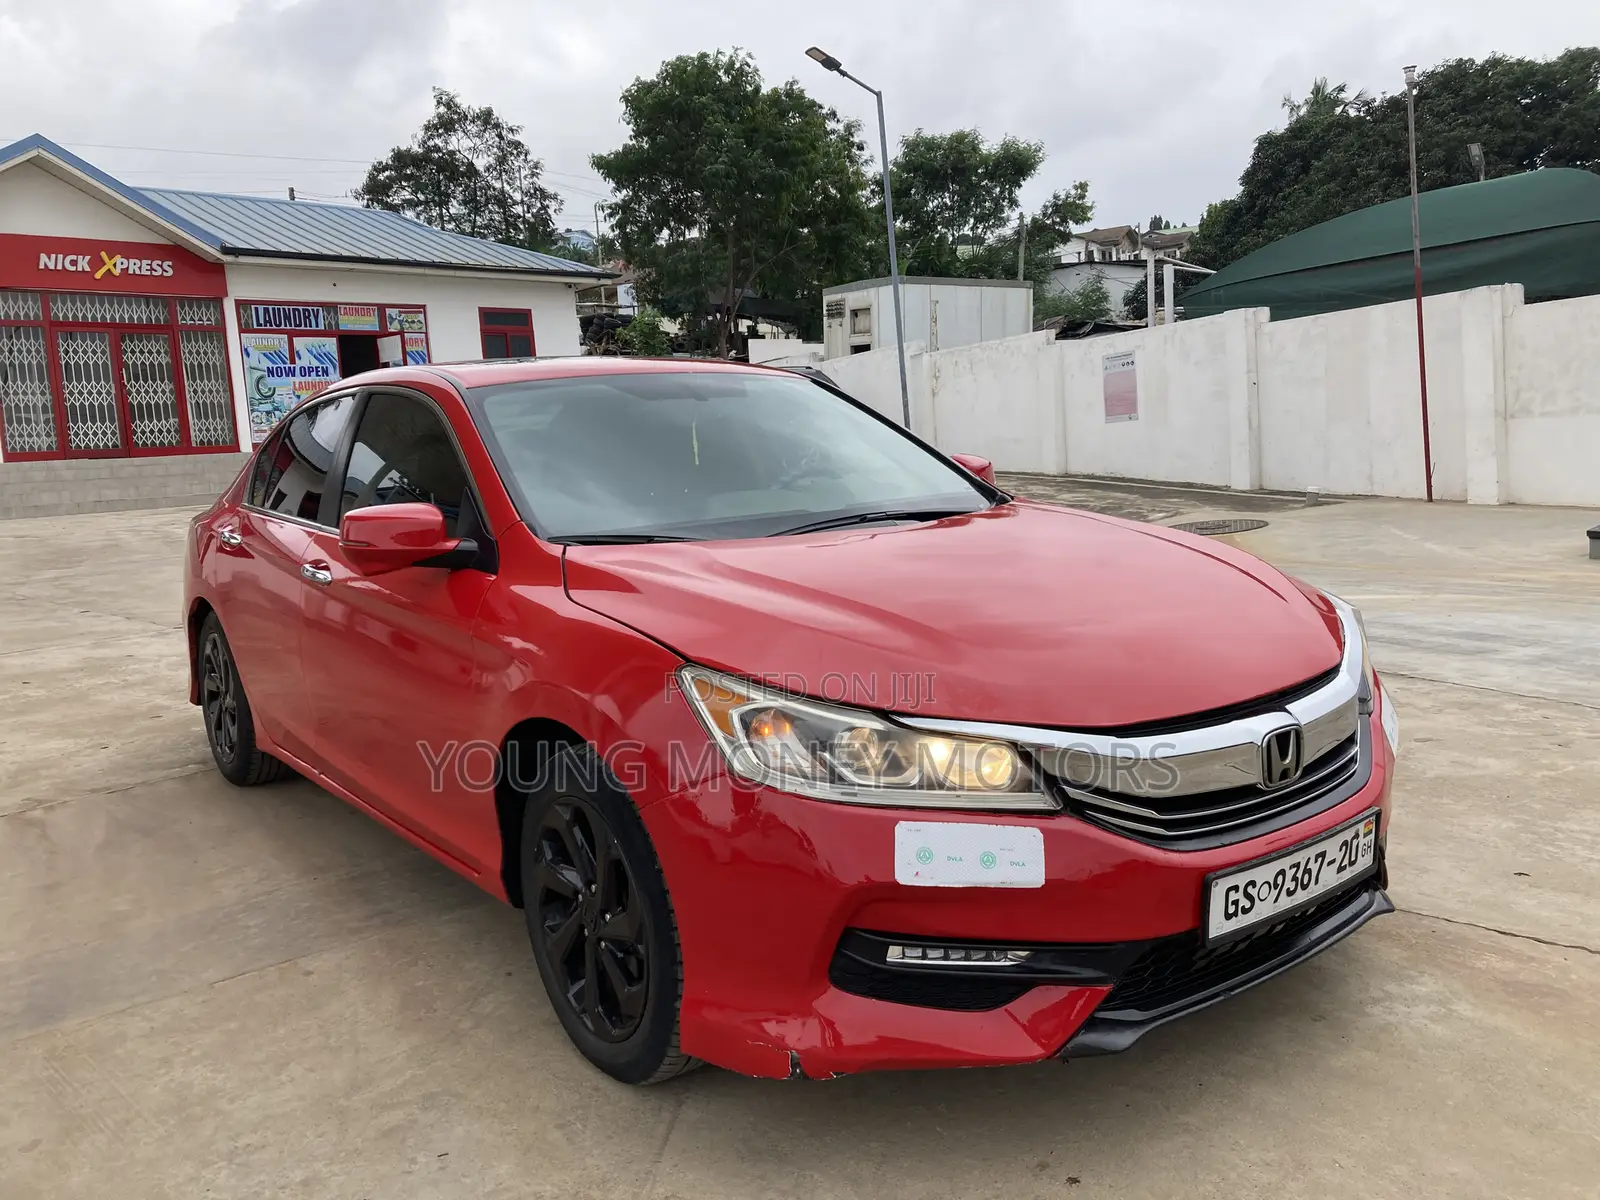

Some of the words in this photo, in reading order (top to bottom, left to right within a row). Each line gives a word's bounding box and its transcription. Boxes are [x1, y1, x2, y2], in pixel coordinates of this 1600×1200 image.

[38, 252, 91, 272] NICK
[93, 250, 174, 280] XPRESS
[253, 306, 320, 329] LAUNDRY
[339, 306, 377, 317] LAUNDRY
[266, 365, 296, 378] NOW
[299, 365, 330, 378] OPEN
[1361, 838, 1373, 858] GH
[946, 855, 963, 863] DVLA
